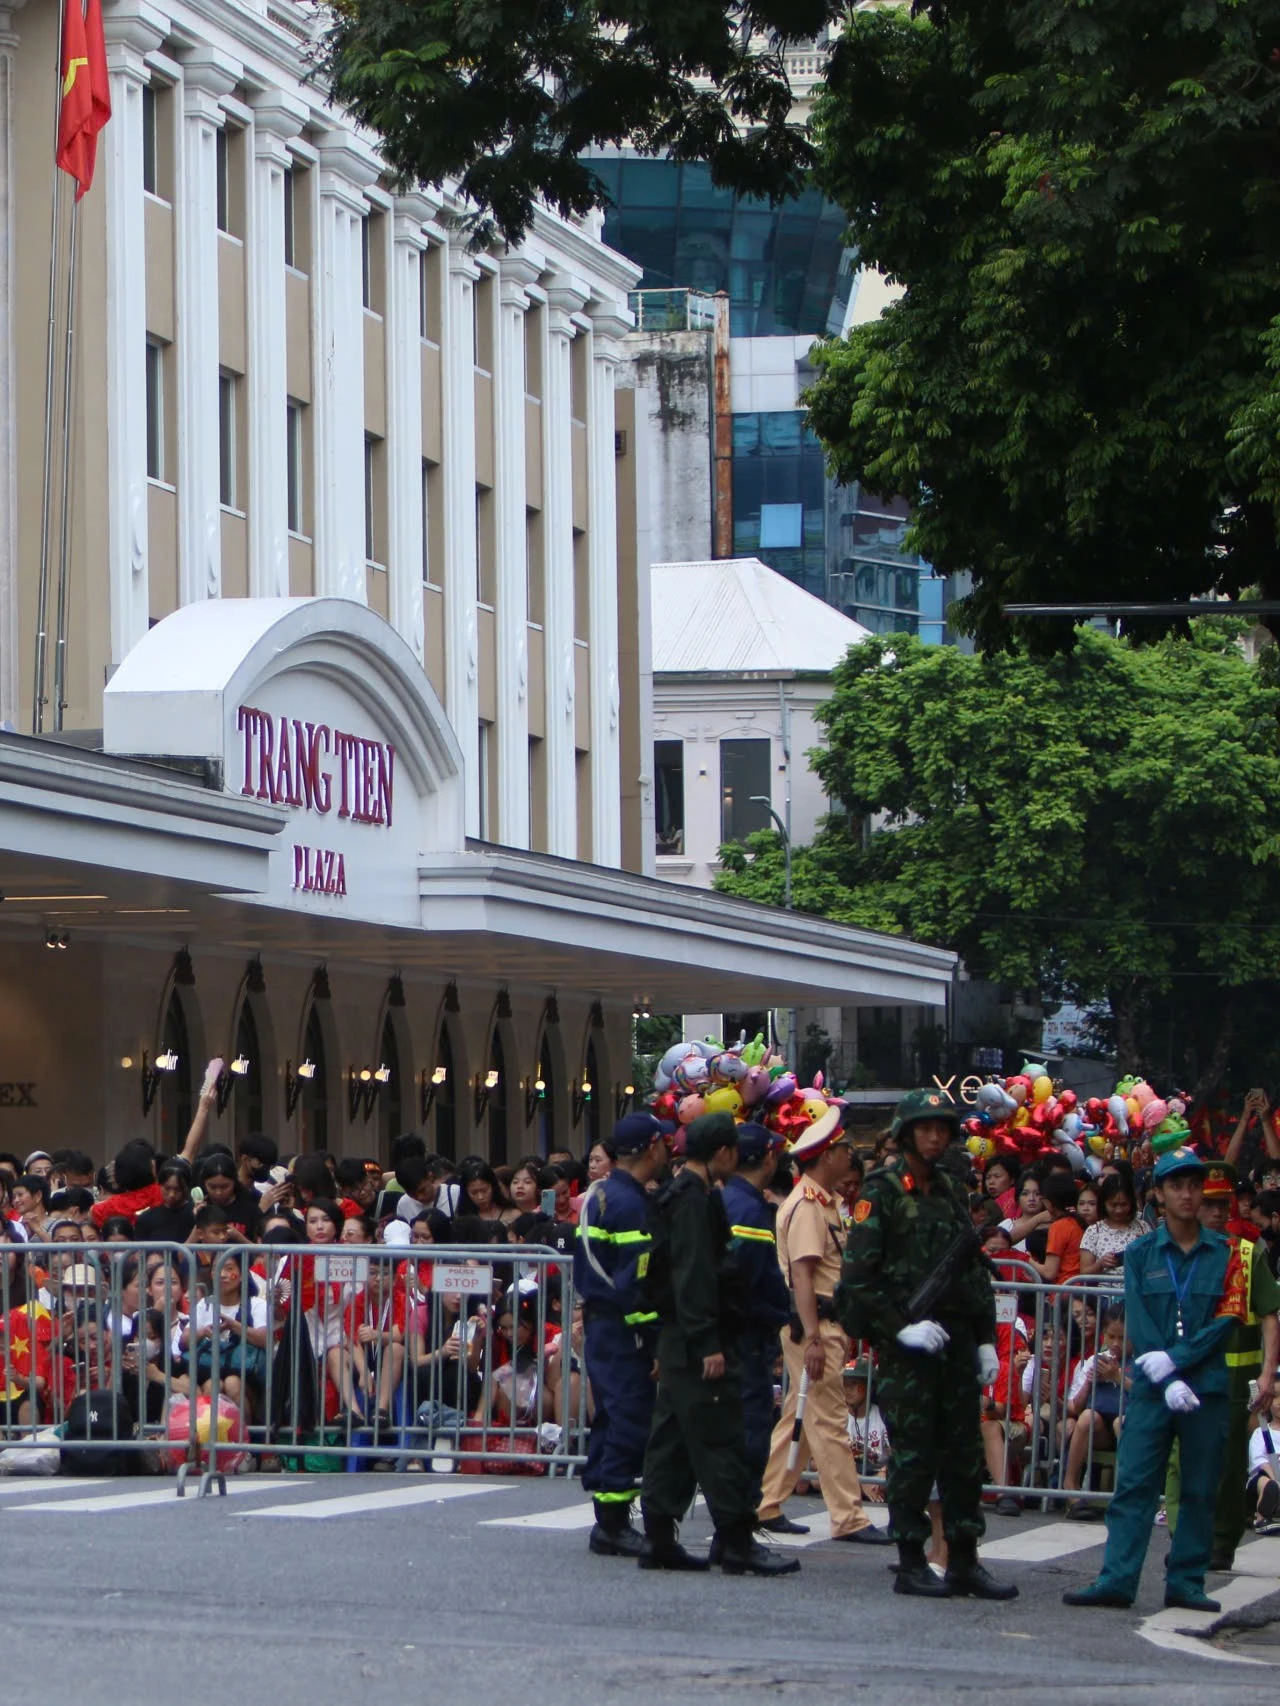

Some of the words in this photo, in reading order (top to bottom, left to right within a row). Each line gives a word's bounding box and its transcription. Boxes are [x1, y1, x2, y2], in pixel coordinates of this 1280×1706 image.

[237, 704, 332, 813] TRANG
[334, 729, 396, 827] TIEN
[292, 844, 347, 895] PLAZA
[444, 1278, 479, 1288] STOP
